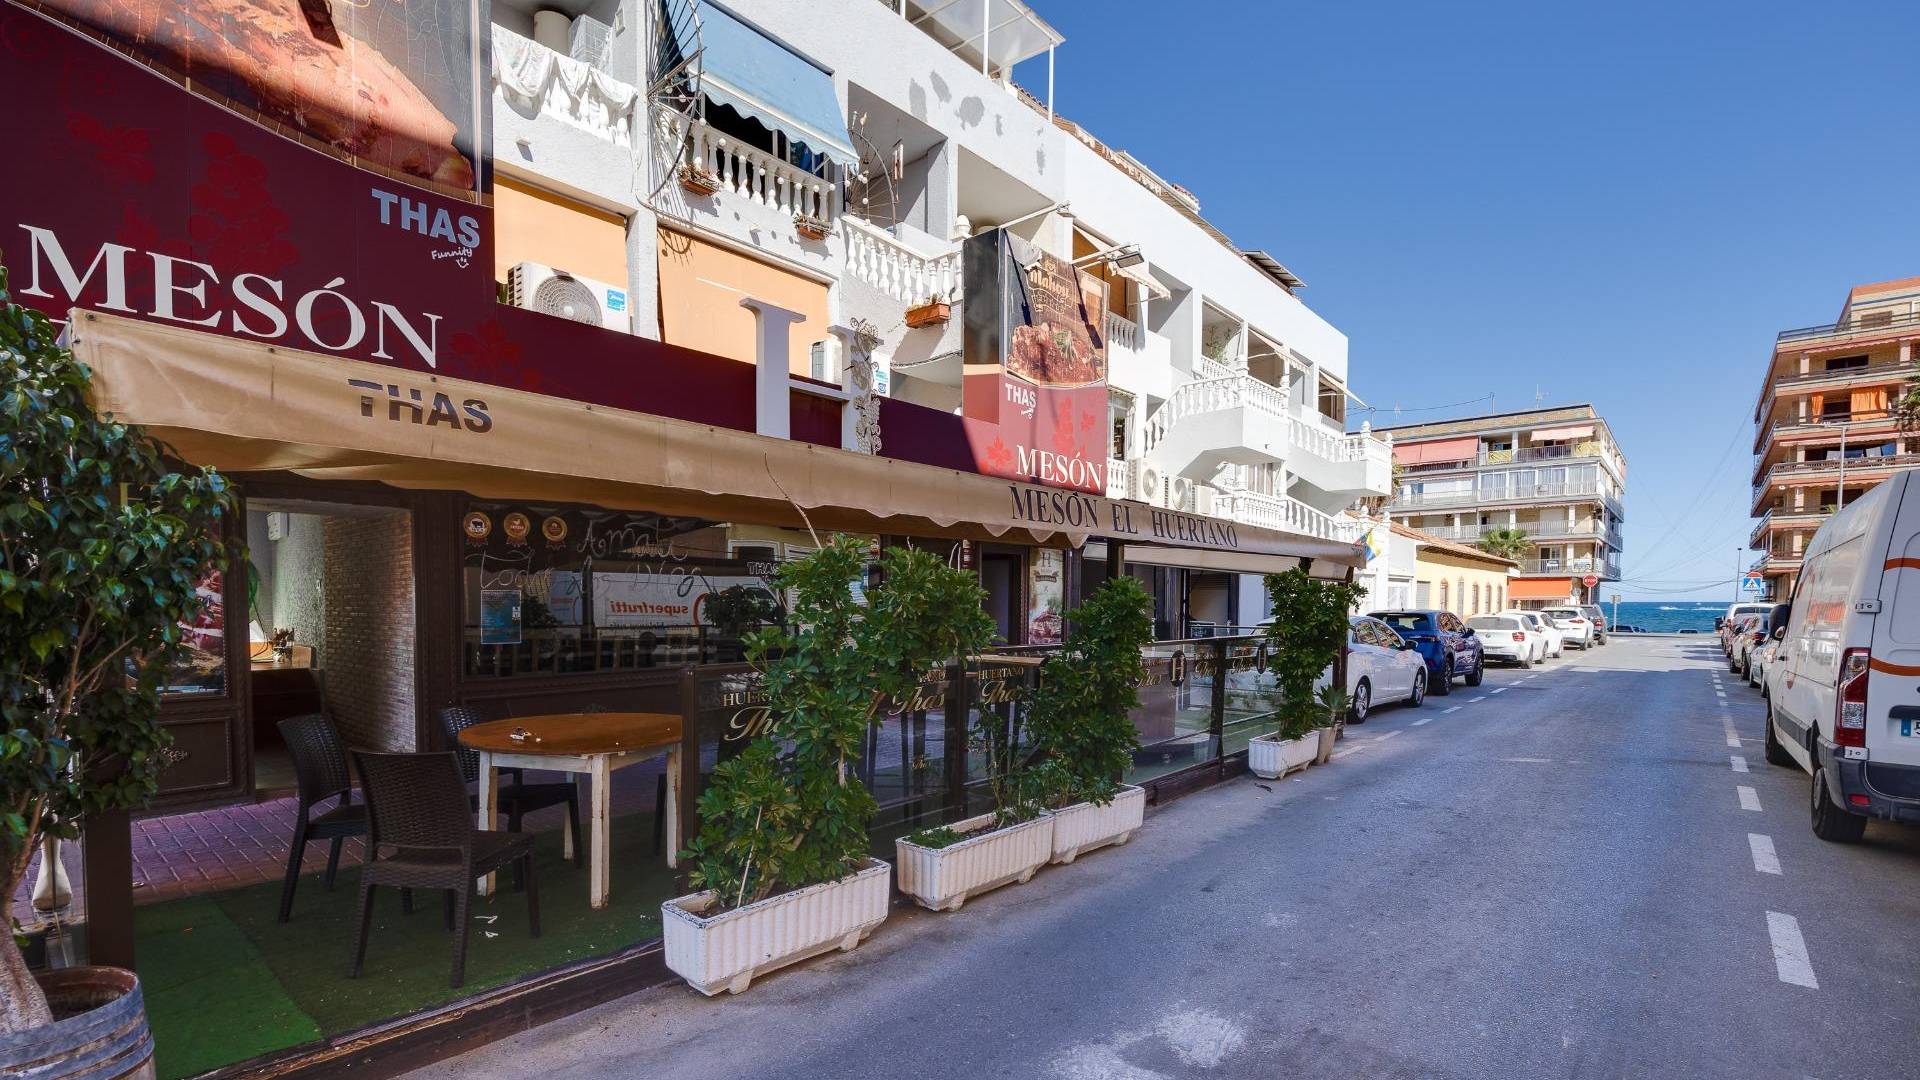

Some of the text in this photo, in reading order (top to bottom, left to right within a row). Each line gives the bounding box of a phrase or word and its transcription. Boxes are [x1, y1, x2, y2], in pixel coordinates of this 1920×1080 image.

[371, 187, 480, 249] THAS
[18, 223, 443, 369] MESÓN
[347, 378, 493, 434] THAS
[1005, 382, 1037, 408] THAS
[1016, 445, 1102, 490] MESÓN
[1112, 503, 1138, 535] EL
[1151, 510, 1239, 549] HUERTANO
[978, 667, 1024, 680] HUERTANO
